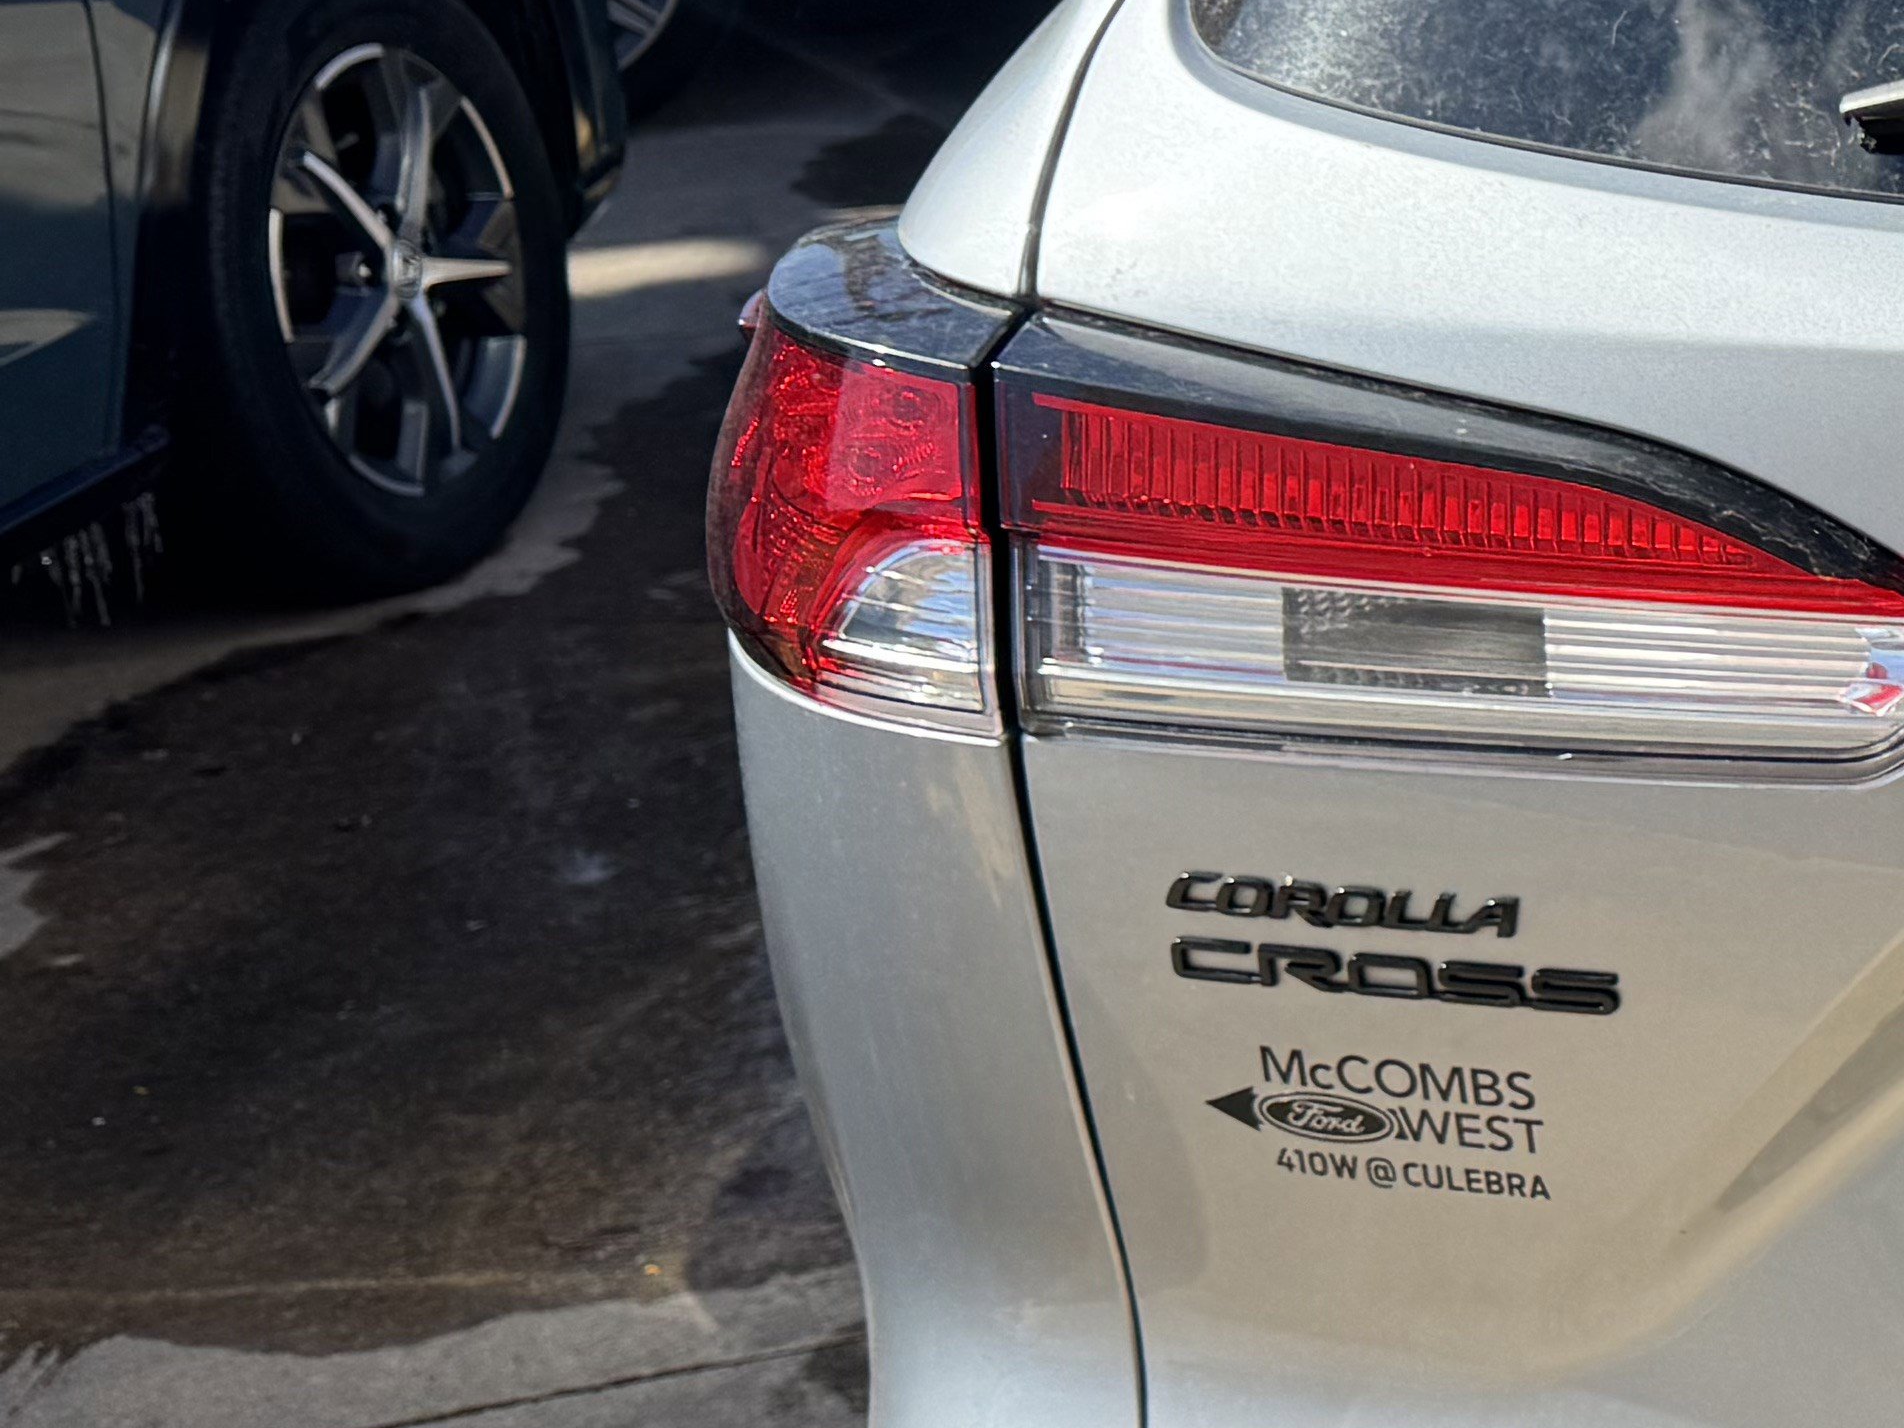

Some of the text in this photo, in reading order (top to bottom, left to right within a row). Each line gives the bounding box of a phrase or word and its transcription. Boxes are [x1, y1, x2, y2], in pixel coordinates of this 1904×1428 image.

[1166, 871, 1519, 938] COROLLA
[1170, 936, 1621, 1015] CROSS
[1259, 1045, 1536, 1111] McCOMBS
[1287, 1100, 1544, 1154] Ford WEST
[1277, 1147, 1551, 1201] 410W @ CULEBRA
